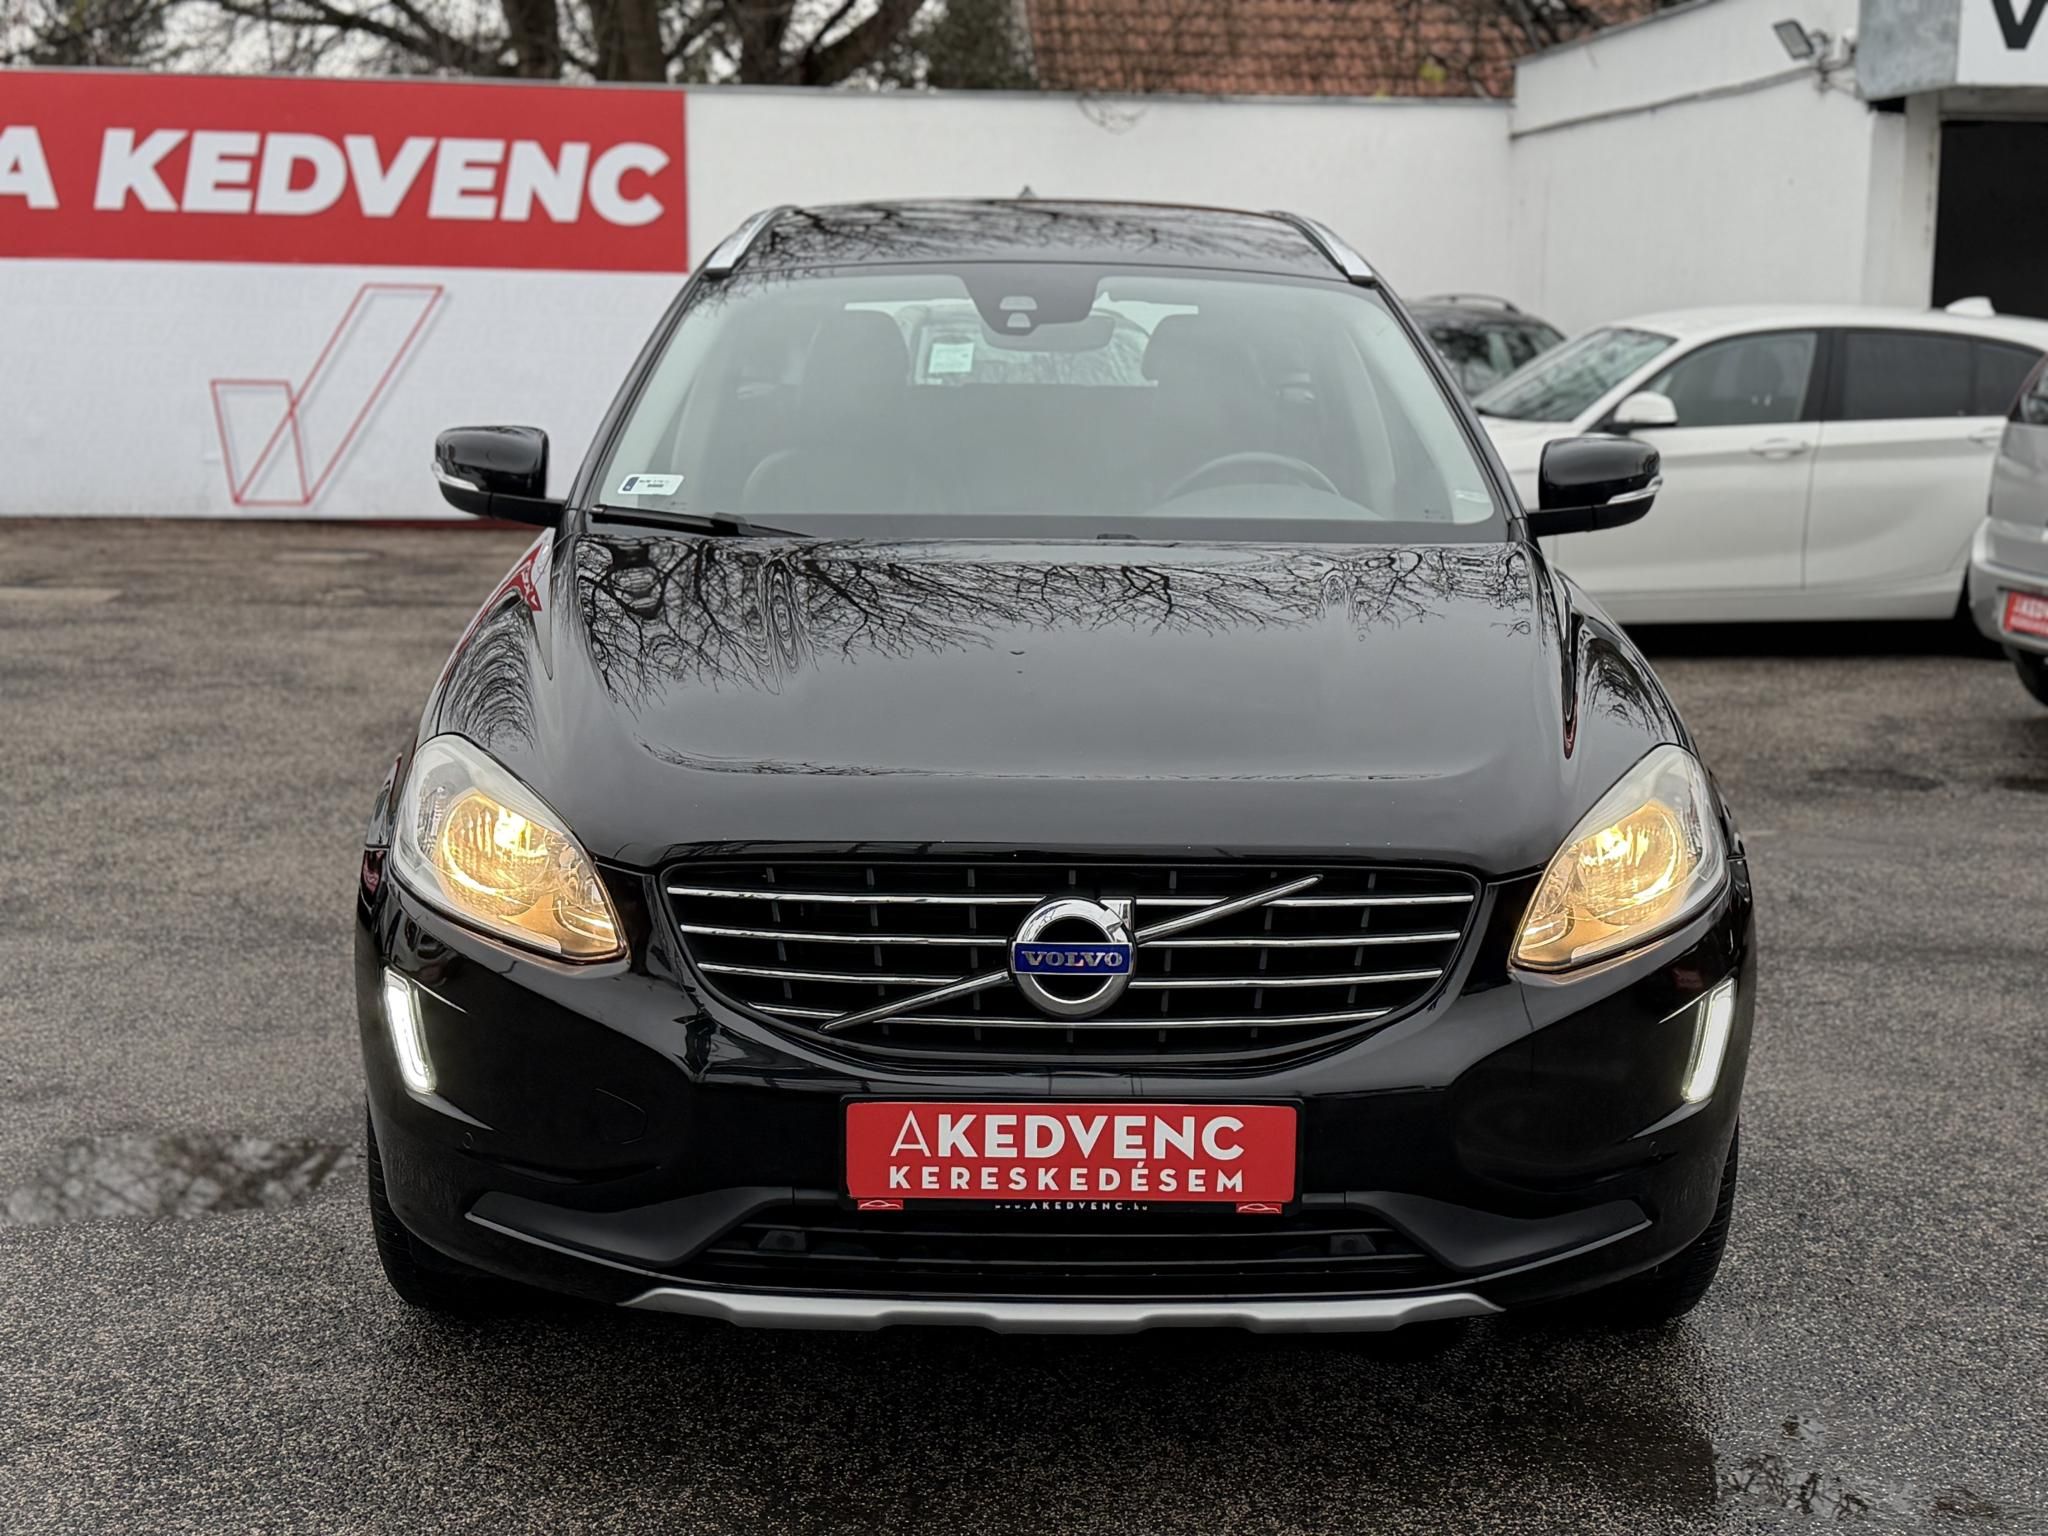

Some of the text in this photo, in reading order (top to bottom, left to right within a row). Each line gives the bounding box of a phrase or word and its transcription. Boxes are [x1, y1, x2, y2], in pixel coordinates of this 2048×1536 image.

[0, 125, 670, 226] A KEDVENC
[1021, 951, 1123, 967] VOLVO
[890, 1110, 1244, 1161] AKEDVENC
[889, 1161, 1243, 1193] KERESKEDÉSEM
